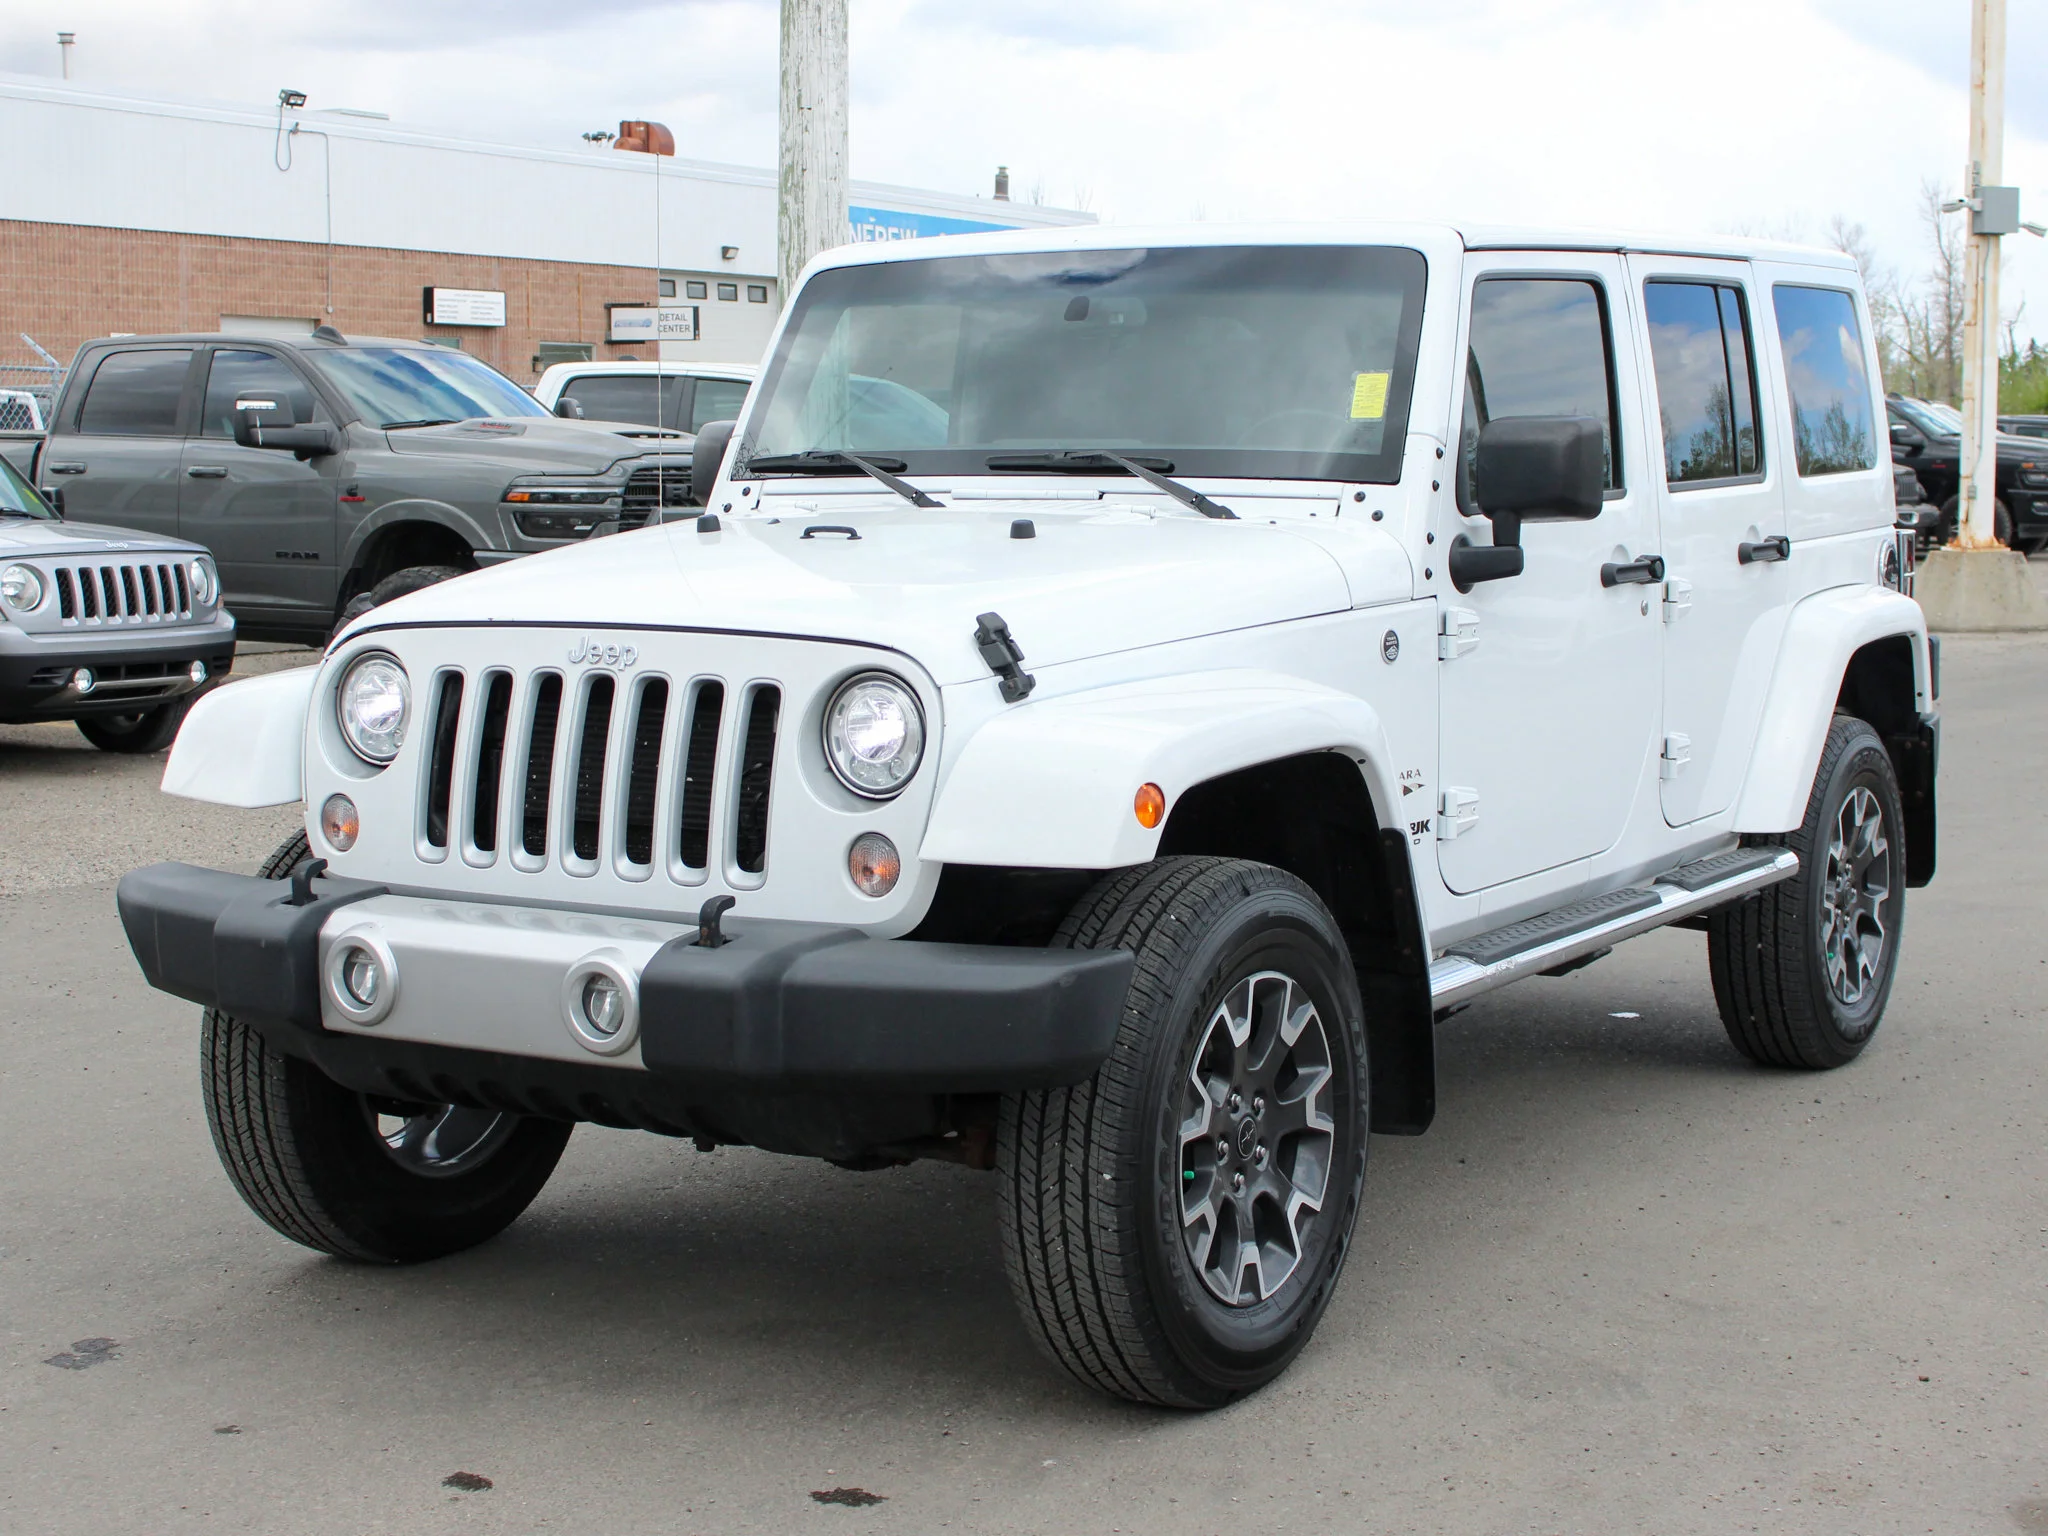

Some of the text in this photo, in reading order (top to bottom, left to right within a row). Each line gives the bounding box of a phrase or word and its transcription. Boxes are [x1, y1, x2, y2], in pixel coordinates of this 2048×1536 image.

[660, 313, 688, 322] DETAIL
[658, 324, 691, 333] CENTER
[568, 635, 639, 671] Jeep
[1399, 768, 1421, 780] ARA
